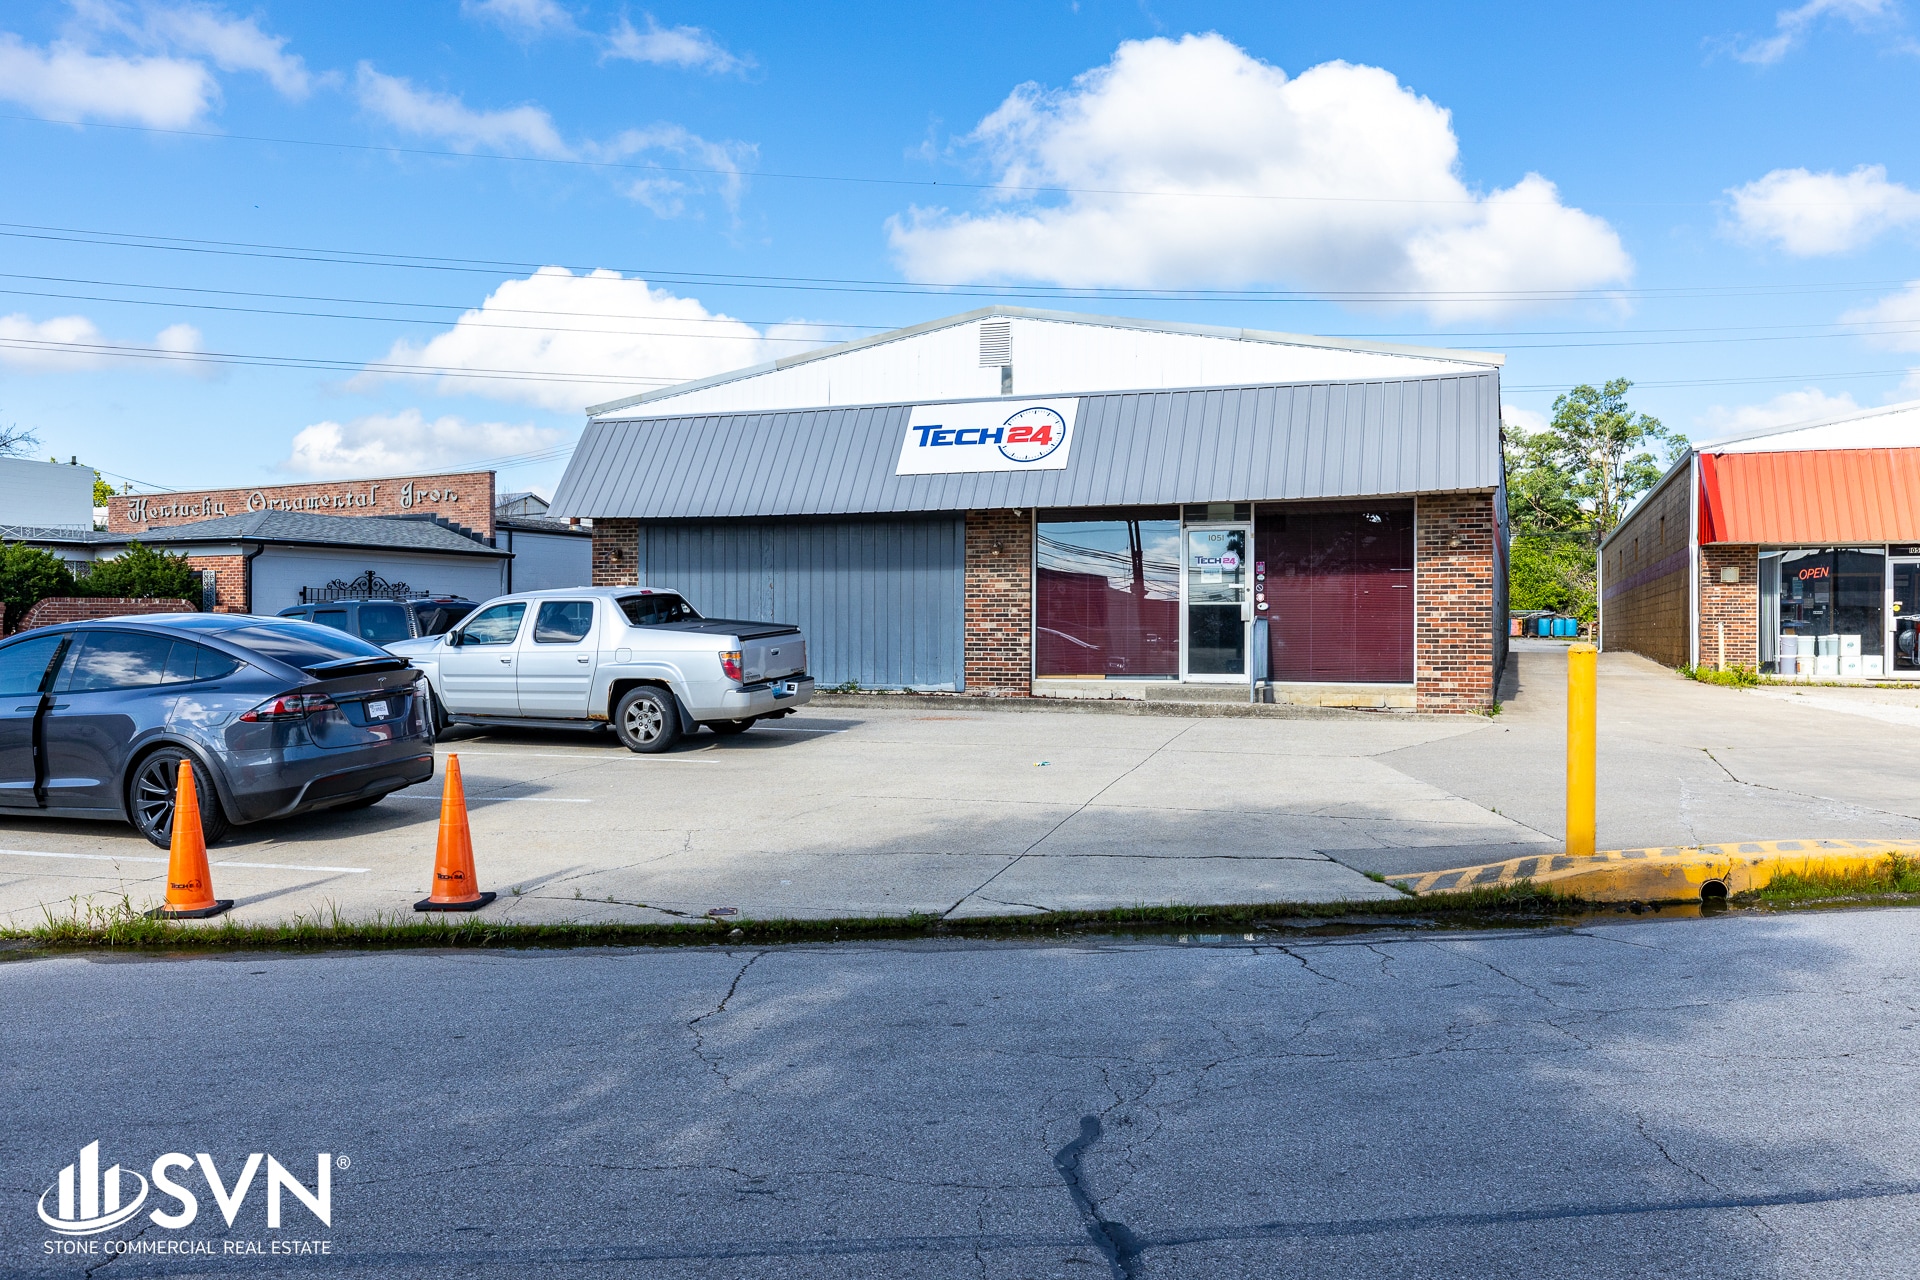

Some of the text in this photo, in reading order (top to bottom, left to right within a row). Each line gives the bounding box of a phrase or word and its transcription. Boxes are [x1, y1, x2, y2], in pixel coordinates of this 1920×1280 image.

[127, 481, 458, 524] Kentucky Ornamental Iron
[1208, 534, 1225, 542] 1051
[1799, 566, 1830, 580] OPEN
